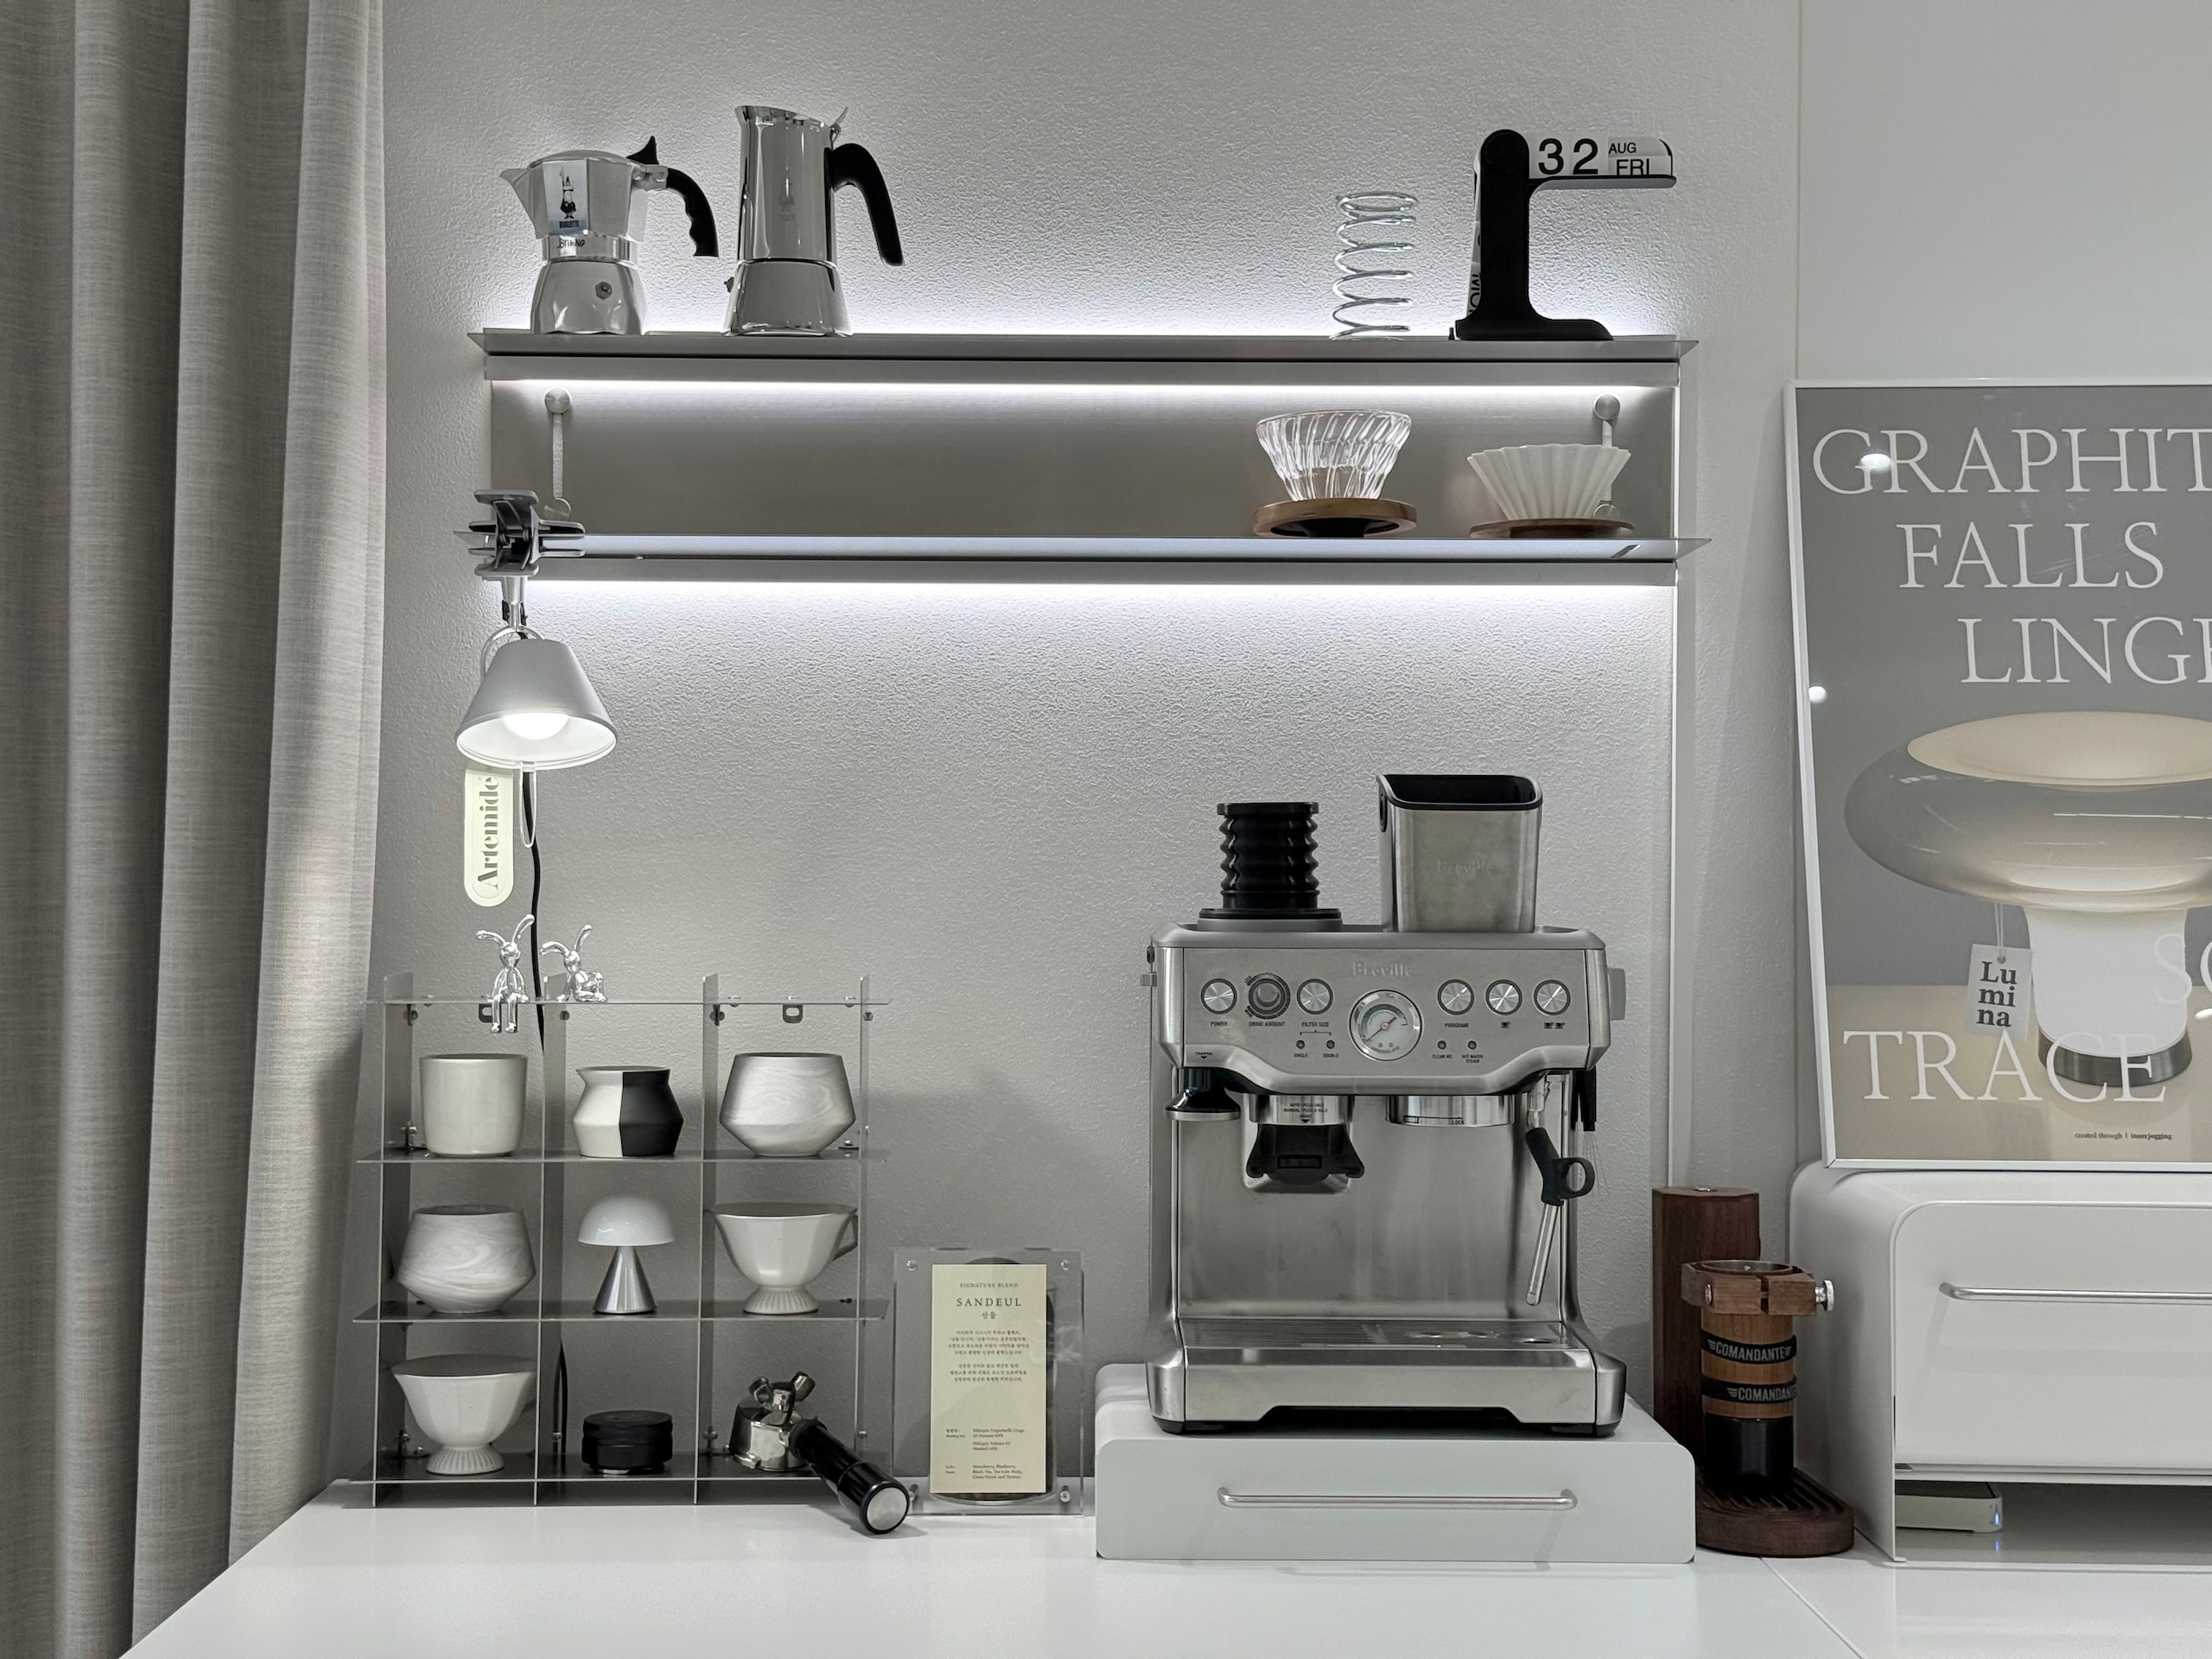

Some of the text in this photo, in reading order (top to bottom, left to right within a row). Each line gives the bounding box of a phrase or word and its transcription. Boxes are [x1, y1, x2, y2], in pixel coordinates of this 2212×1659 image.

[1538, 138, 1599, 175] 32
[1608, 143, 1637, 155] AUG
[1617, 158, 1650, 176] FRI
[1896, 521, 2164, 588] FALLS
[477, 777, 499, 891] Artemide
[1352, 961, 1414, 977] Breville
[1980, 961, 2018, 985] Lu
[2153, 933, 2212, 1004] S
[1978, 986, 2016, 1007] mi
[1976, 1009, 2012, 1027] na
[1843, 1028, 2166, 1103] TRACE
[2098, 1132, 2123, 1141] through
[957, 1298, 1022, 1307] SANDEUL
[1715, 1341, 1785, 1362] COMANDANTE
